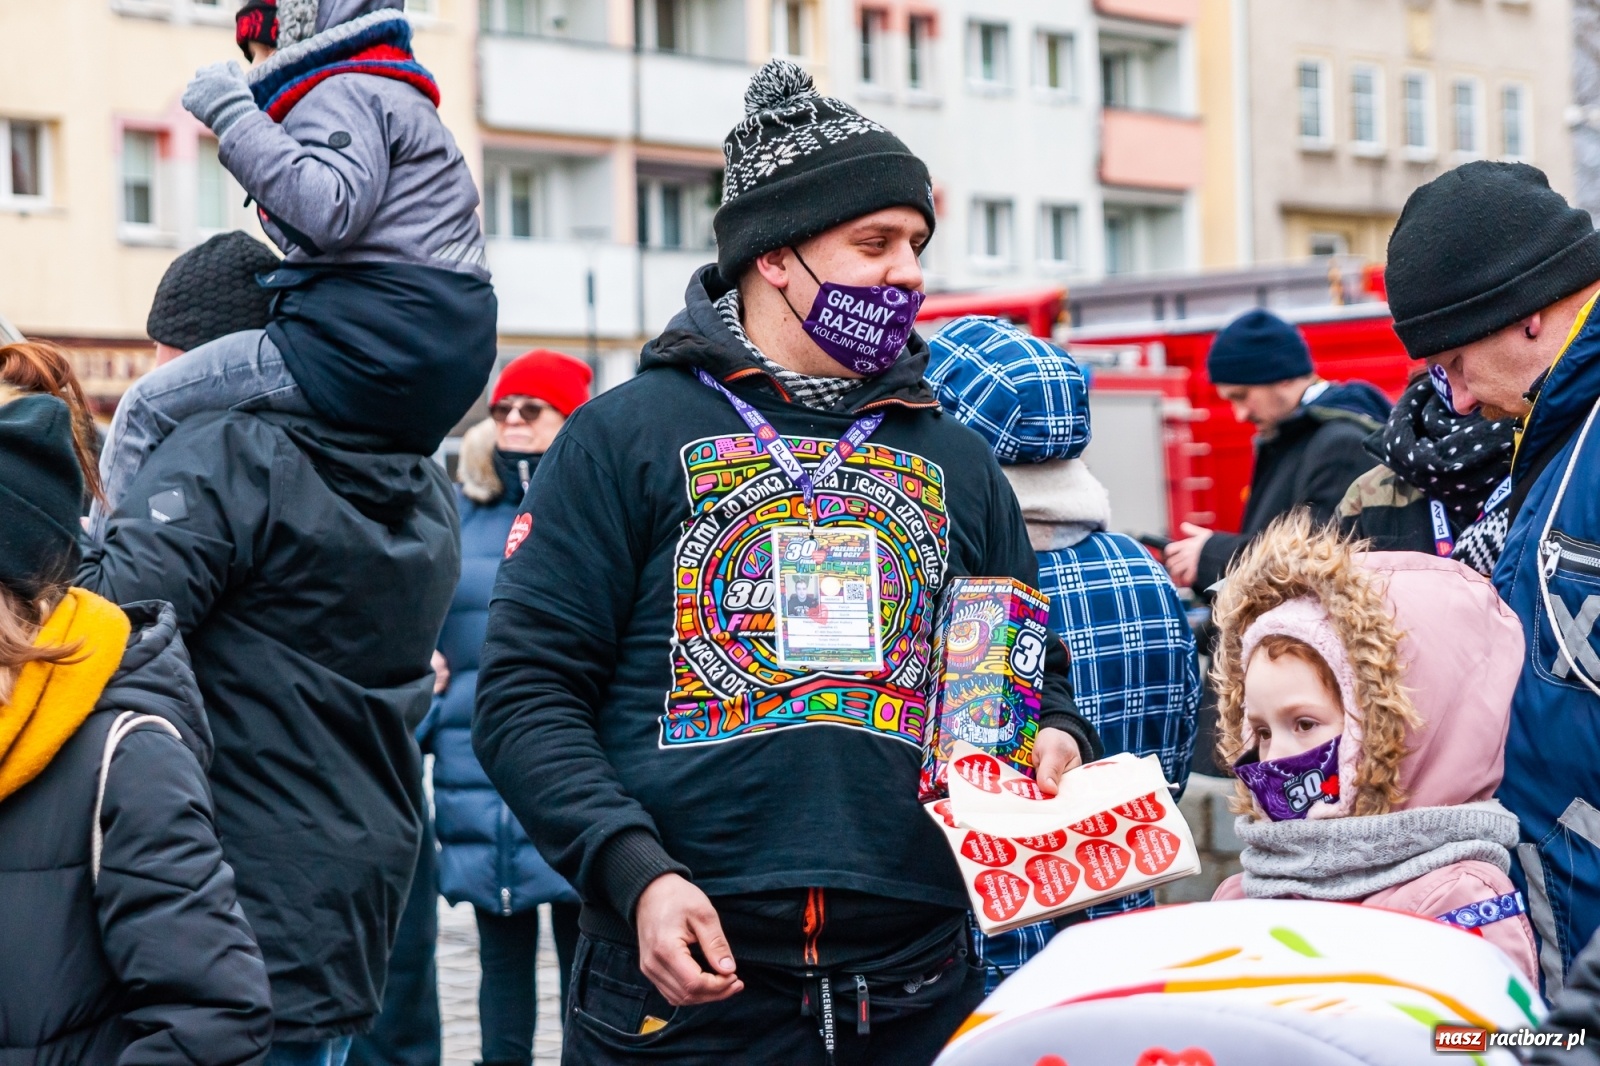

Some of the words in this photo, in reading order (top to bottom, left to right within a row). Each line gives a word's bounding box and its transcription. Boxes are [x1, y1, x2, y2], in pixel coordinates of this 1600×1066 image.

[827, 290, 895, 325] GRAMY
[812, 325, 857, 350] KOLEJNY
[856, 343, 878, 357] ROK
[818, 307, 884, 345] RAZEM
[773, 445, 800, 474] PLAY
[814, 456, 840, 481] PLAY
[1486, 480, 1510, 508] PLAY
[679, 514, 720, 567] gramy
[722, 499, 741, 519] do
[738, 476, 785, 507] końca
[843, 474, 849, 490] i
[852, 475, 896, 507] jeden
[896, 505, 928, 541] dzień
[1434, 504, 1446, 535] PLAY
[786, 539, 818, 561] 30
[724, 579, 776, 611] 30
[960, 585, 995, 593] GRAMY
[995, 585, 1013, 593] DLA
[1013, 589, 1050, 612] OKULISTYKI
[1024, 618, 1047, 635] 2022
[686, 634, 728, 681] wielka
[1287, 770, 1323, 811] 30
